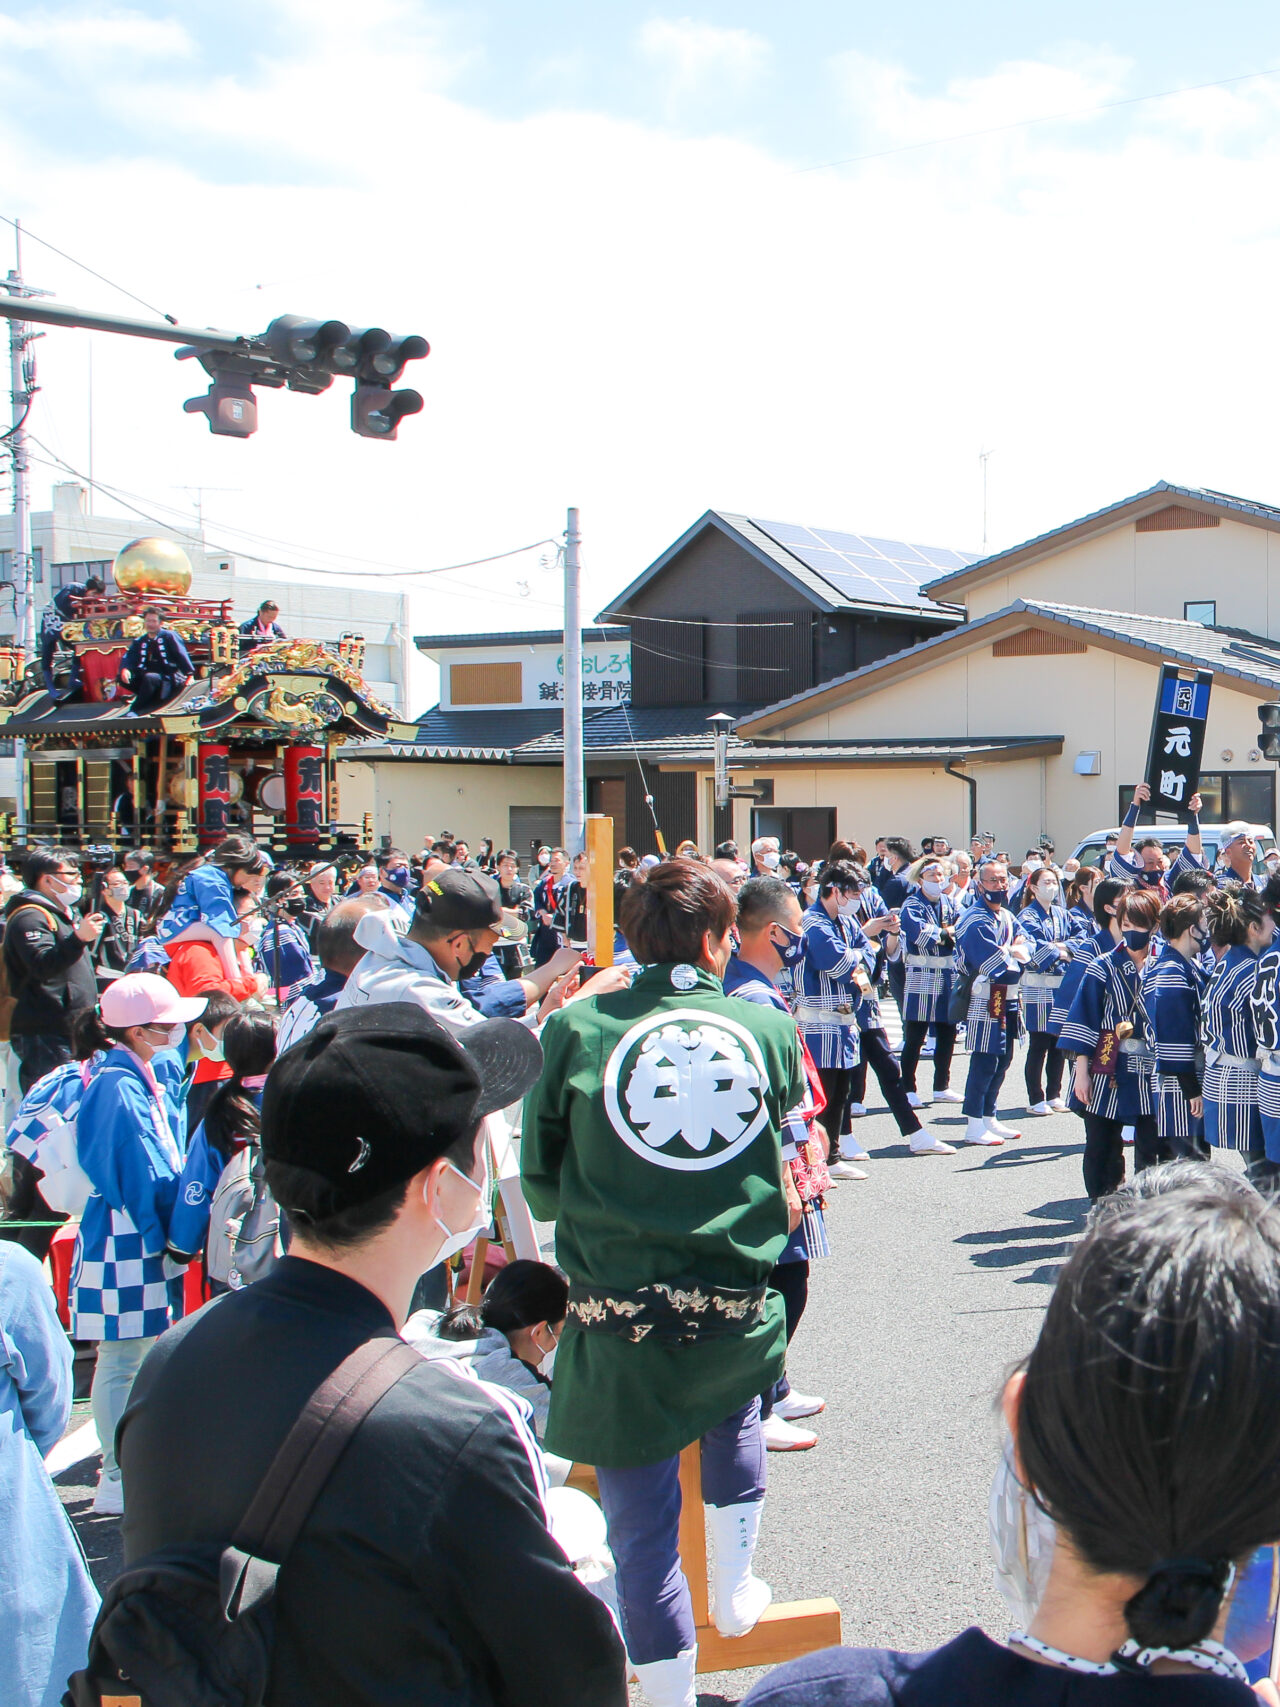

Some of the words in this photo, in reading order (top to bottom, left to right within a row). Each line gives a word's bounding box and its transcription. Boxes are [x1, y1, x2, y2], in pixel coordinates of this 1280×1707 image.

[539, 681, 631, 701] 鍼接骨院
[1177, 686, 1193, 712] 元町
[1160, 726, 1191, 802] 元町
